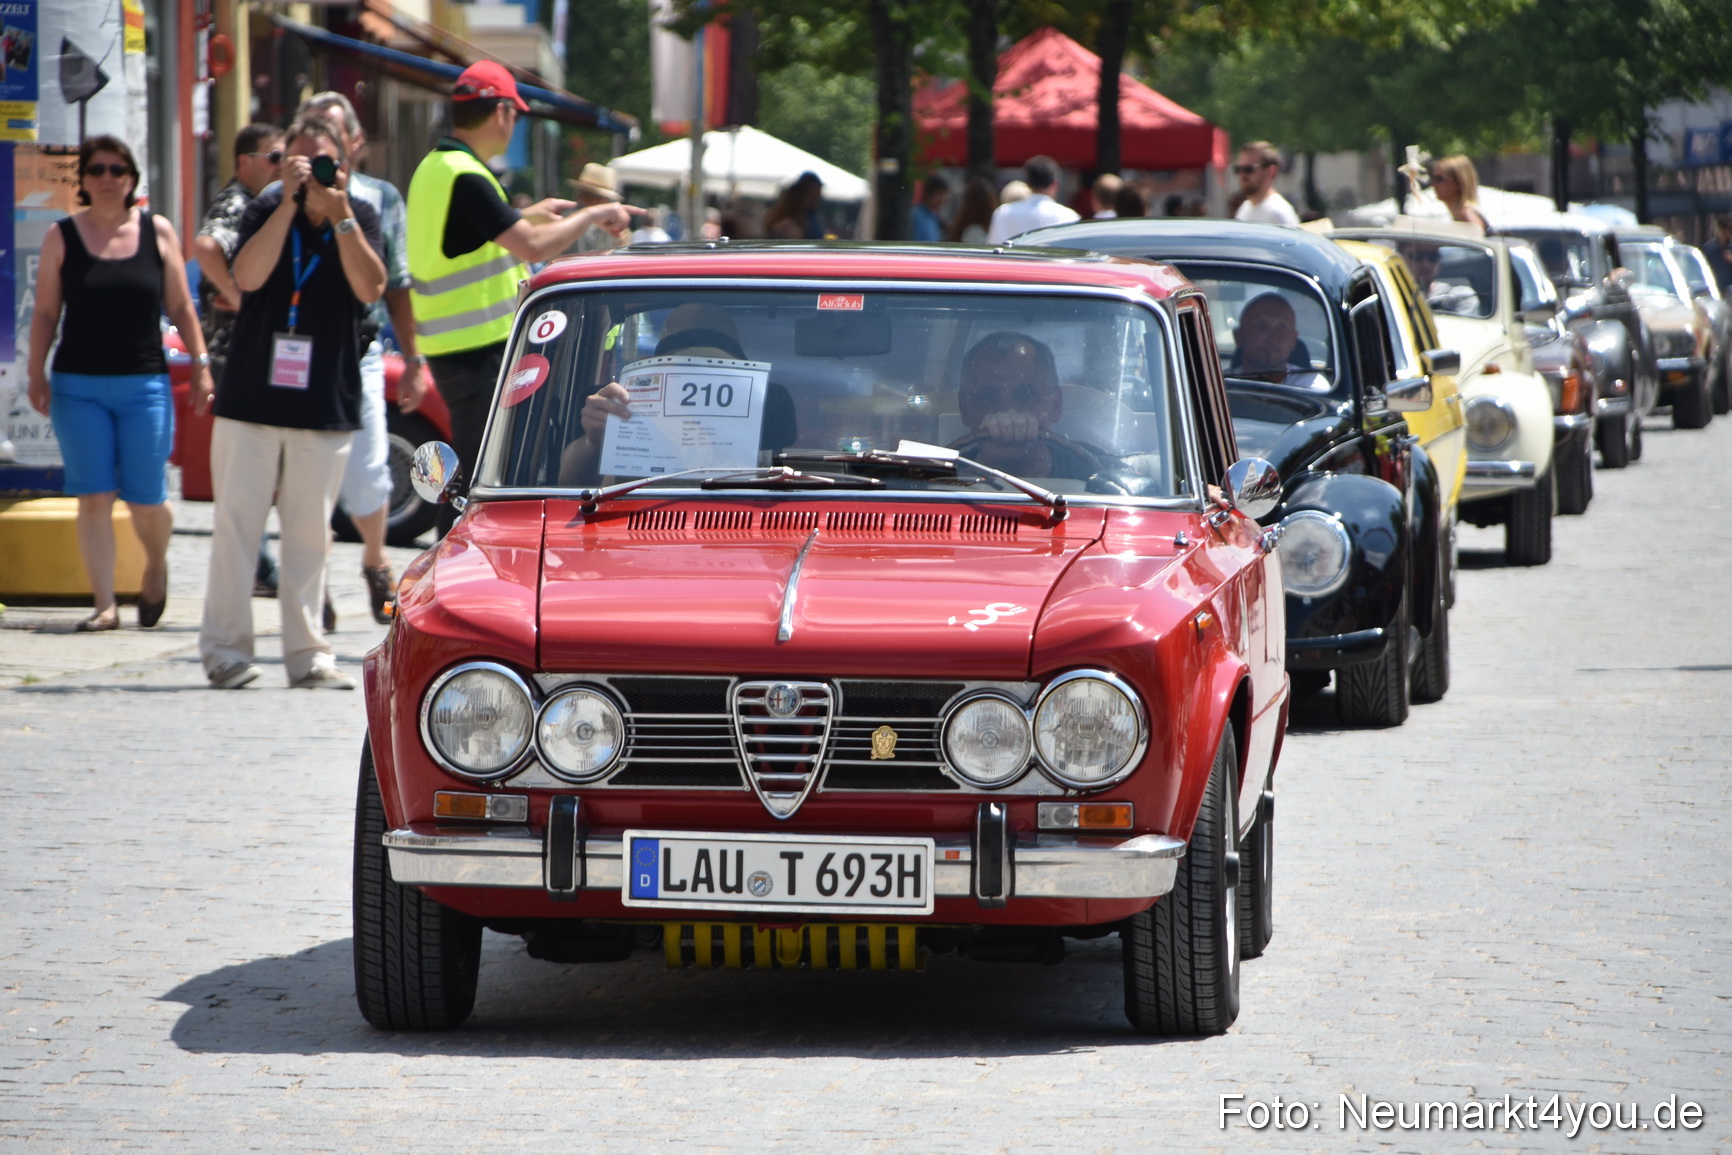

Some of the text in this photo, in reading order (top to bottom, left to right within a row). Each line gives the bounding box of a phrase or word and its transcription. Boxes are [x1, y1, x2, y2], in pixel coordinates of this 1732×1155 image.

[680, 382, 733, 408] 210
[640, 874, 650, 887] D
[662, 847, 922, 898] LAU T 693H
